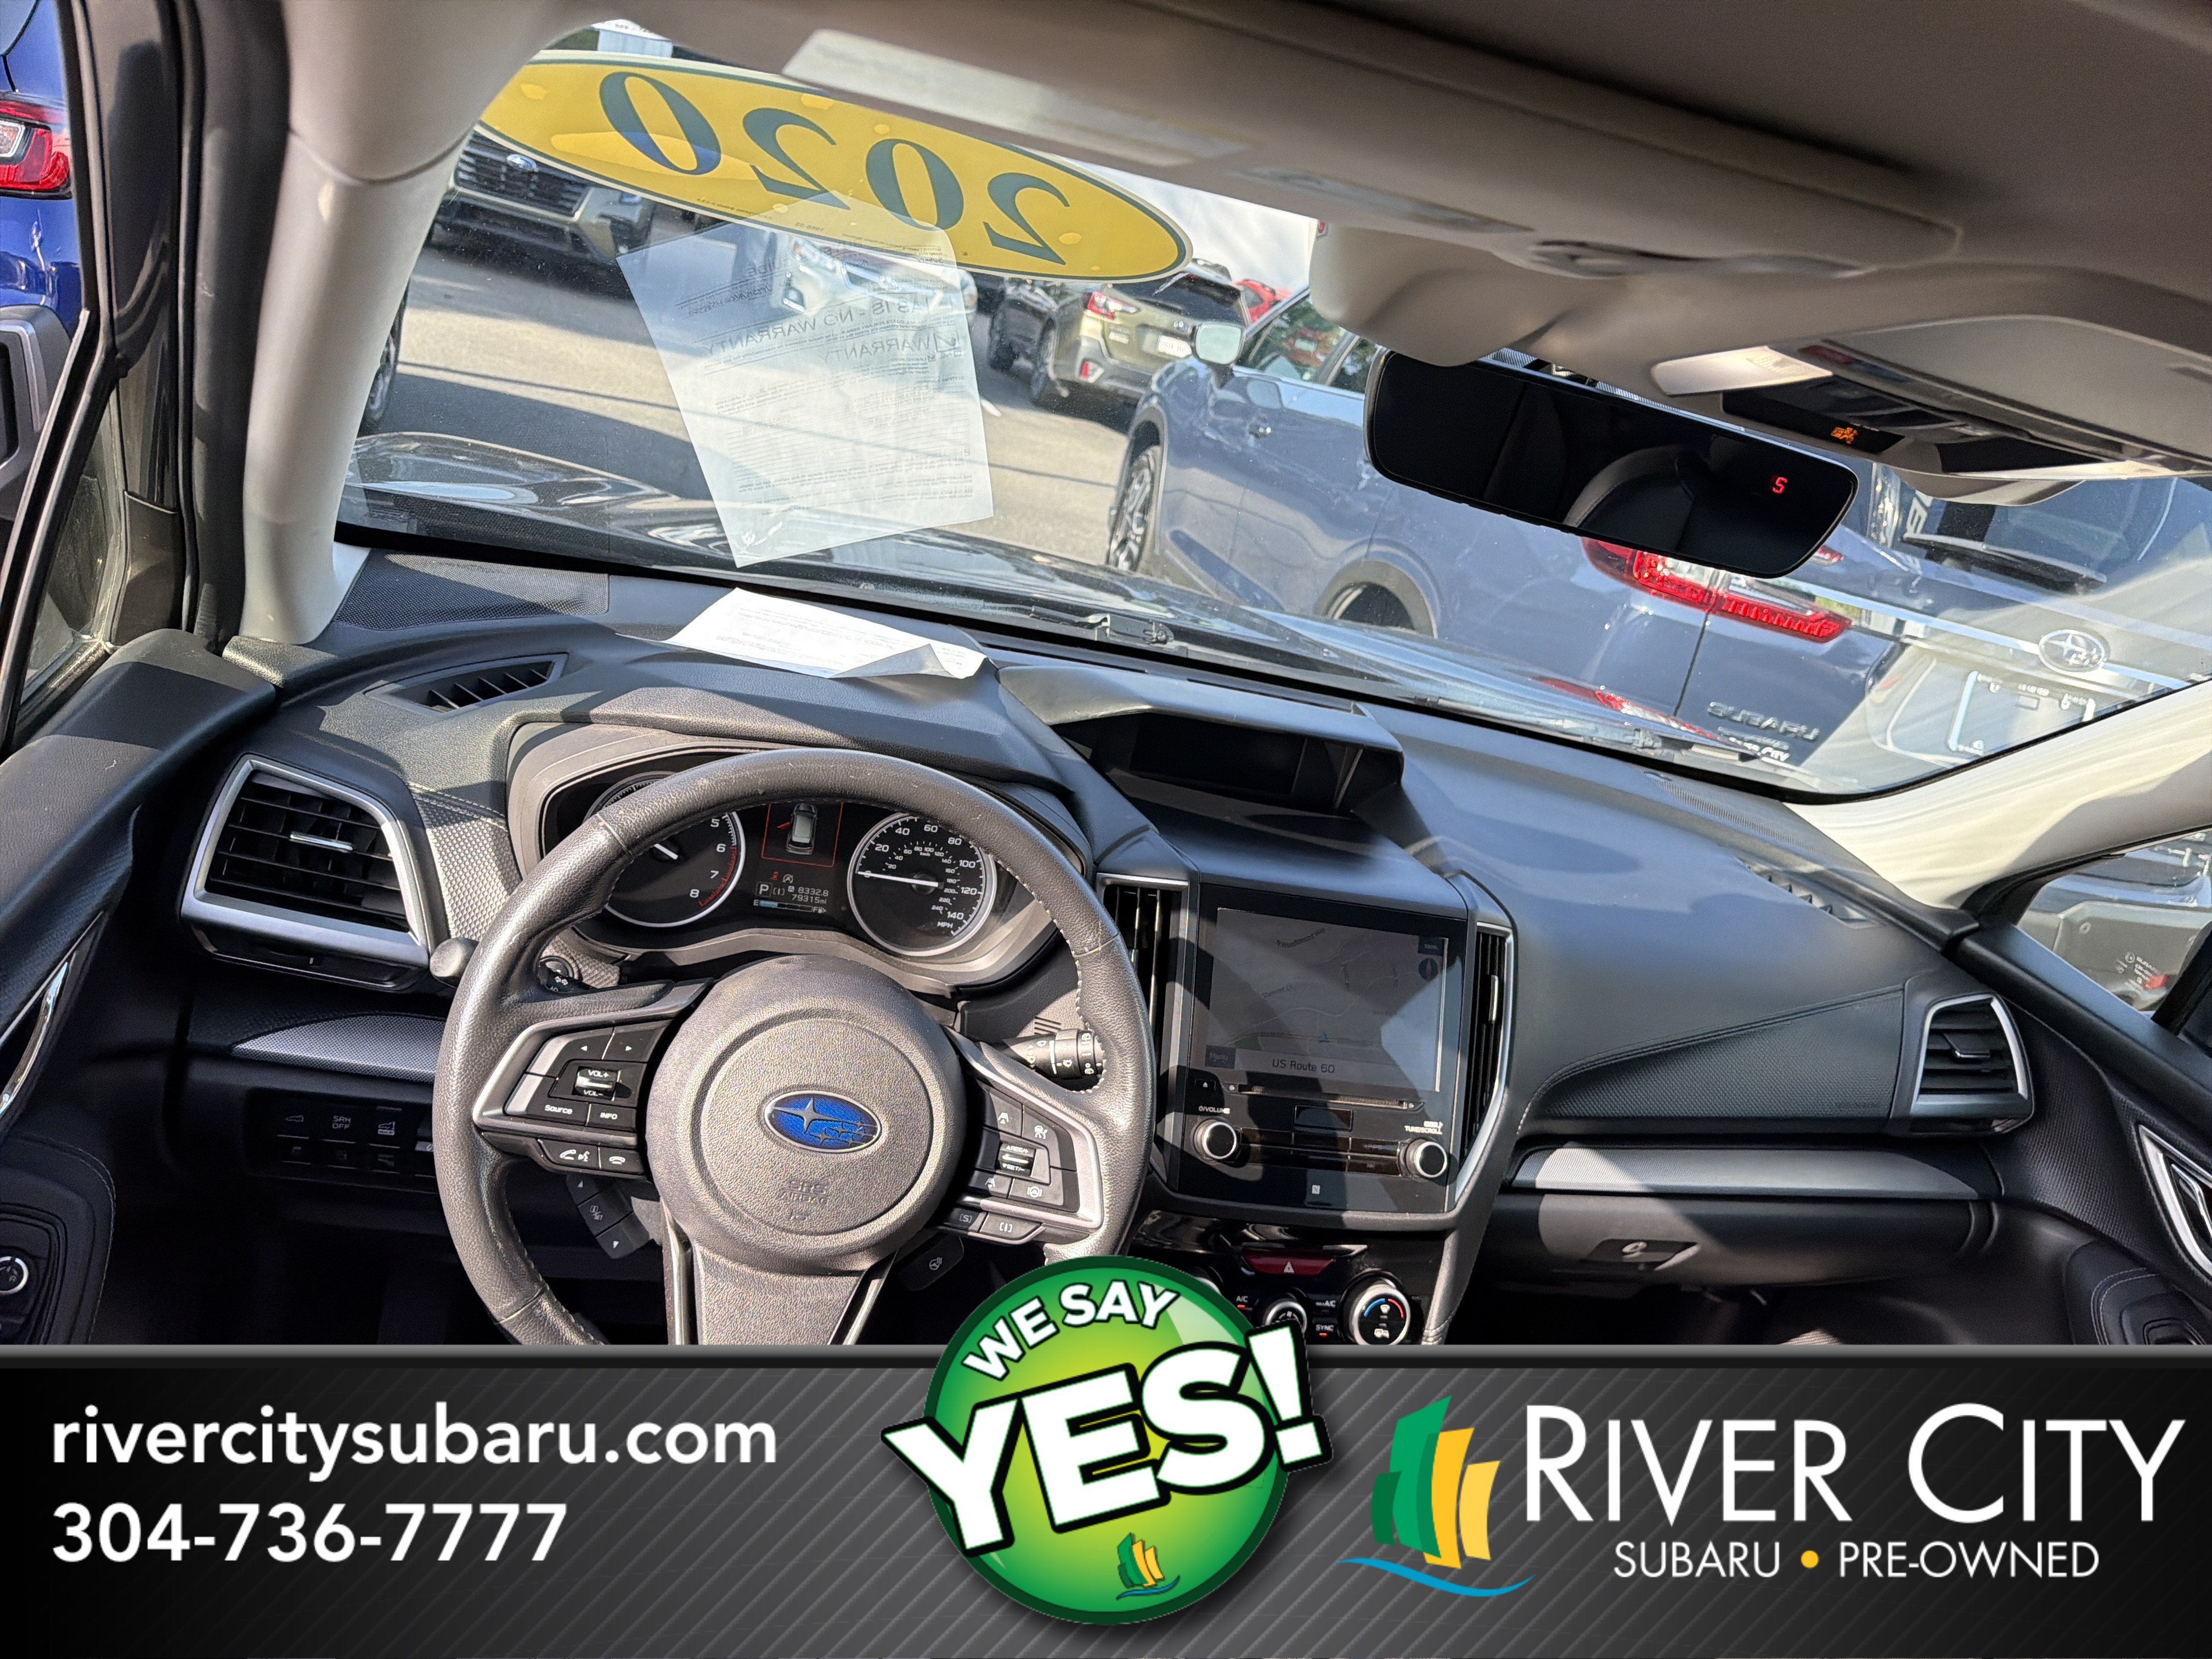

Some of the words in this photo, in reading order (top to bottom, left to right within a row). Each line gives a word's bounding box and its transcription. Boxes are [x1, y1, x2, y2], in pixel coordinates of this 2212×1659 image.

[1707, 702, 1820, 740] SUBARU
[710, 819, 720, 827] 5
[895, 827, 910, 836] 40
[924, 825, 938, 833] 60
[948, 837, 962, 845] 80
[716, 843, 726, 853] 6
[874, 844, 889, 853] 20
[959, 859, 976, 868] 100
[710, 870, 719, 879] 7
[689, 889, 699, 898] 8
[759, 884, 769, 895] P
[798, 887, 829, 897] 8332.8
[961, 887, 978, 895] 120
[947, 911, 963, 920] 140
[1272, 1059, 1286, 1068] US
[1290, 1060, 1317, 1071] Route
[1321, 1064, 1335, 1074] 60
[544, 1104, 573, 1115] Source
